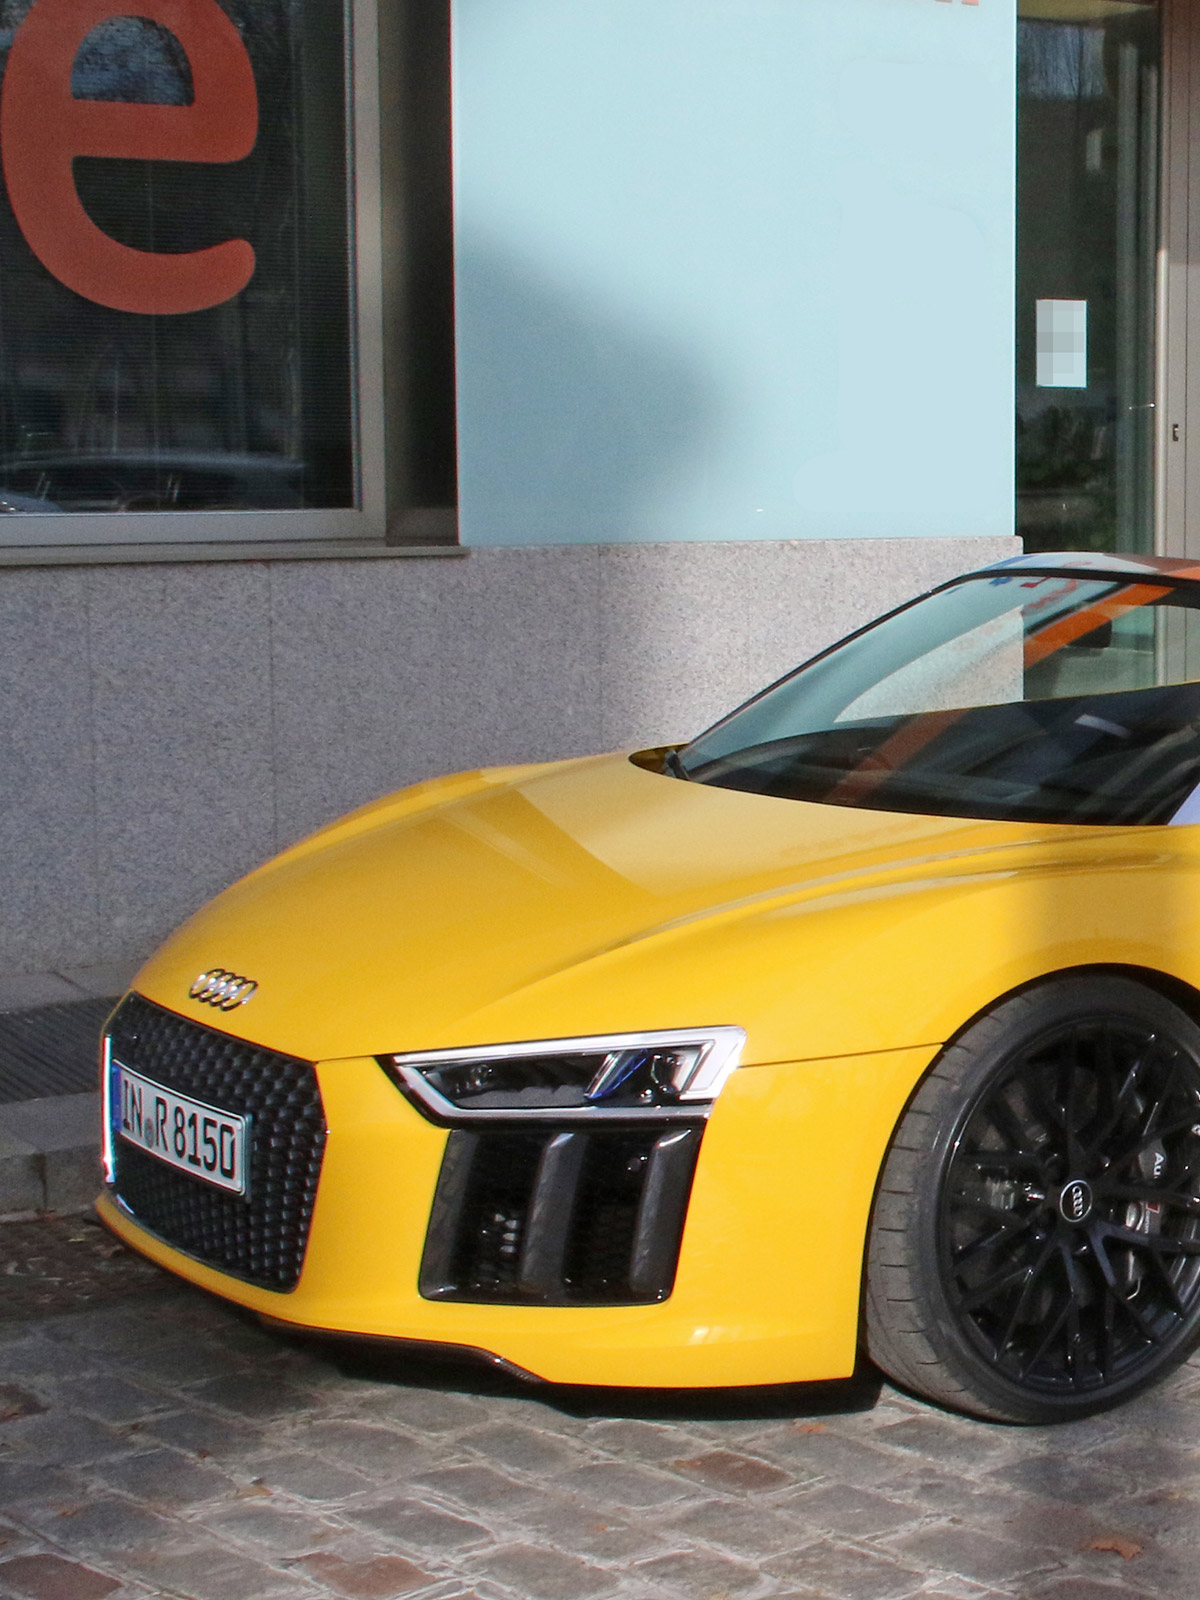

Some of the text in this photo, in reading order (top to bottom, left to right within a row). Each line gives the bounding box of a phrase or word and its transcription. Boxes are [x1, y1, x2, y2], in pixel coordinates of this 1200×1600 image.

[0, 0, 259, 315] e
[123, 1079, 236, 1180] IN R 8150
